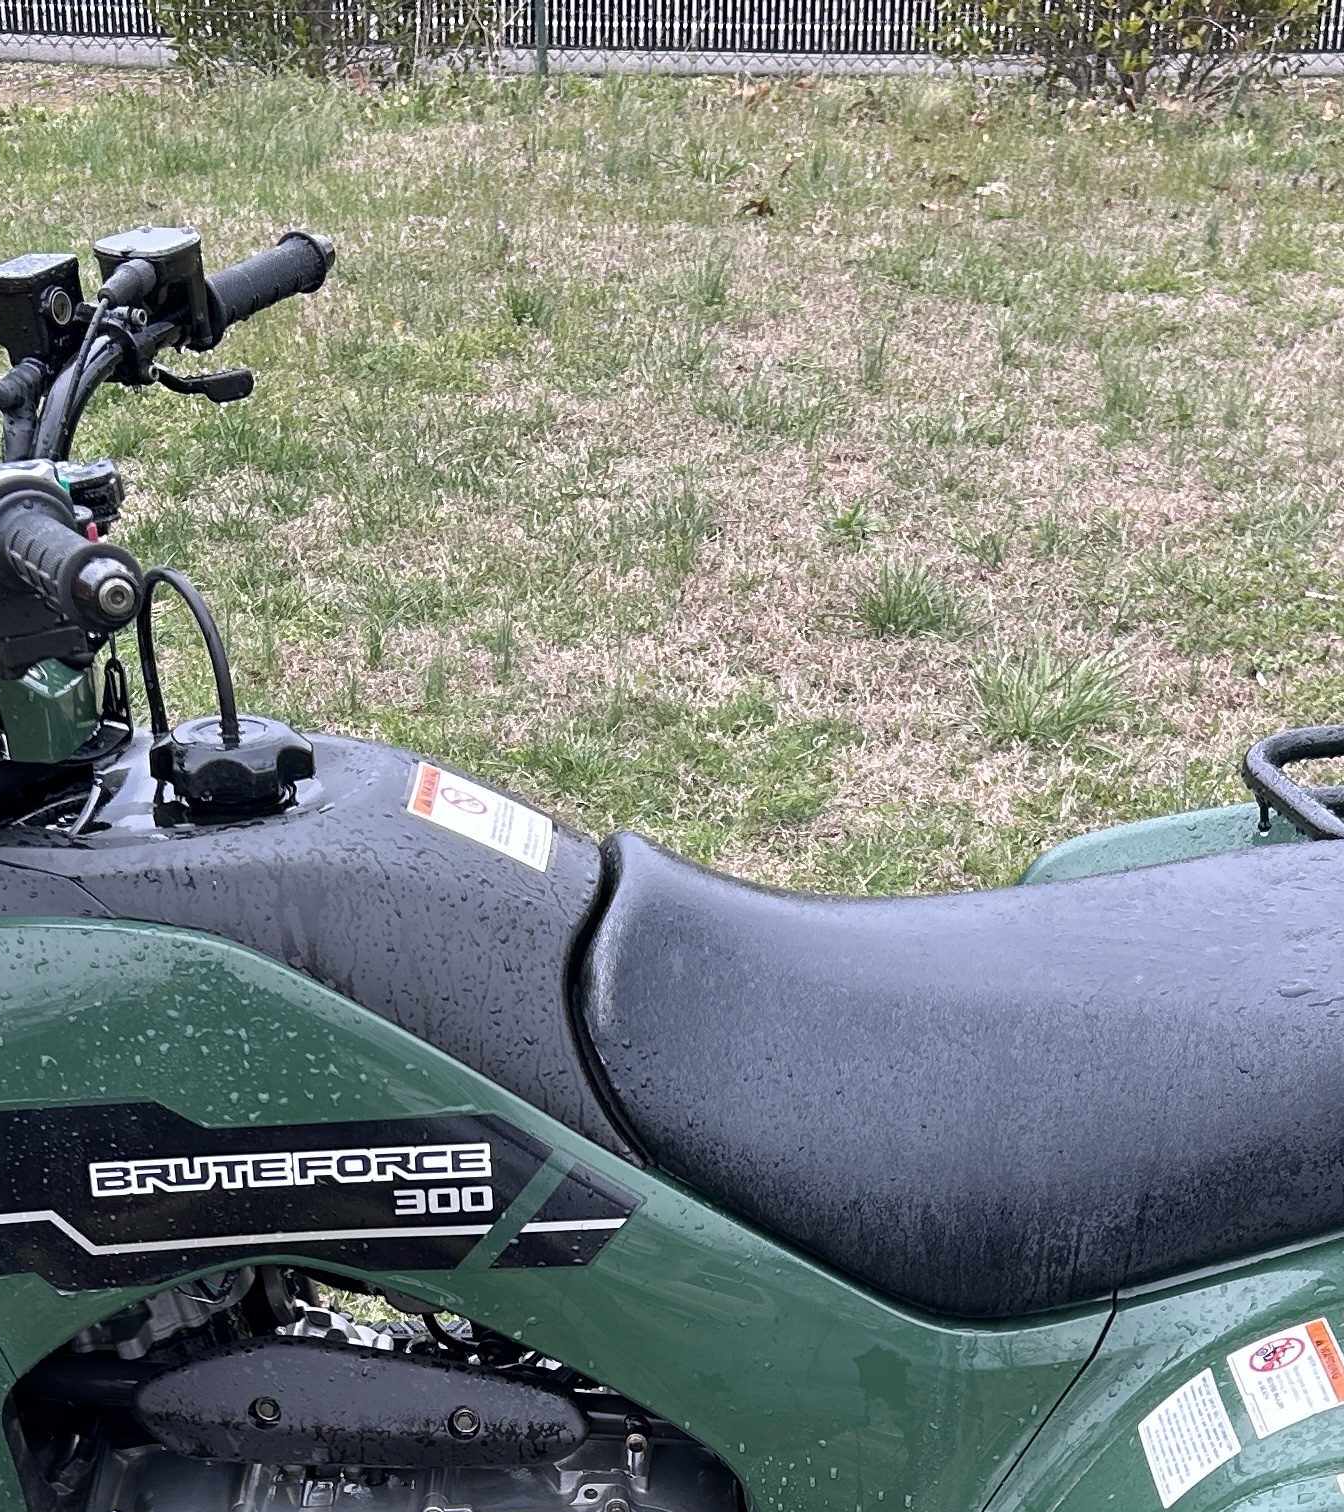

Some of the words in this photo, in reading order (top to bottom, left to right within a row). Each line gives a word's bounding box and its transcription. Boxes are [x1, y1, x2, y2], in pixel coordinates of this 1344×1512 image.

[88, 1157, 292, 1198] BRUTE
[293, 1142, 492, 1187] FORCE
[394, 1186, 494, 1216] 300
